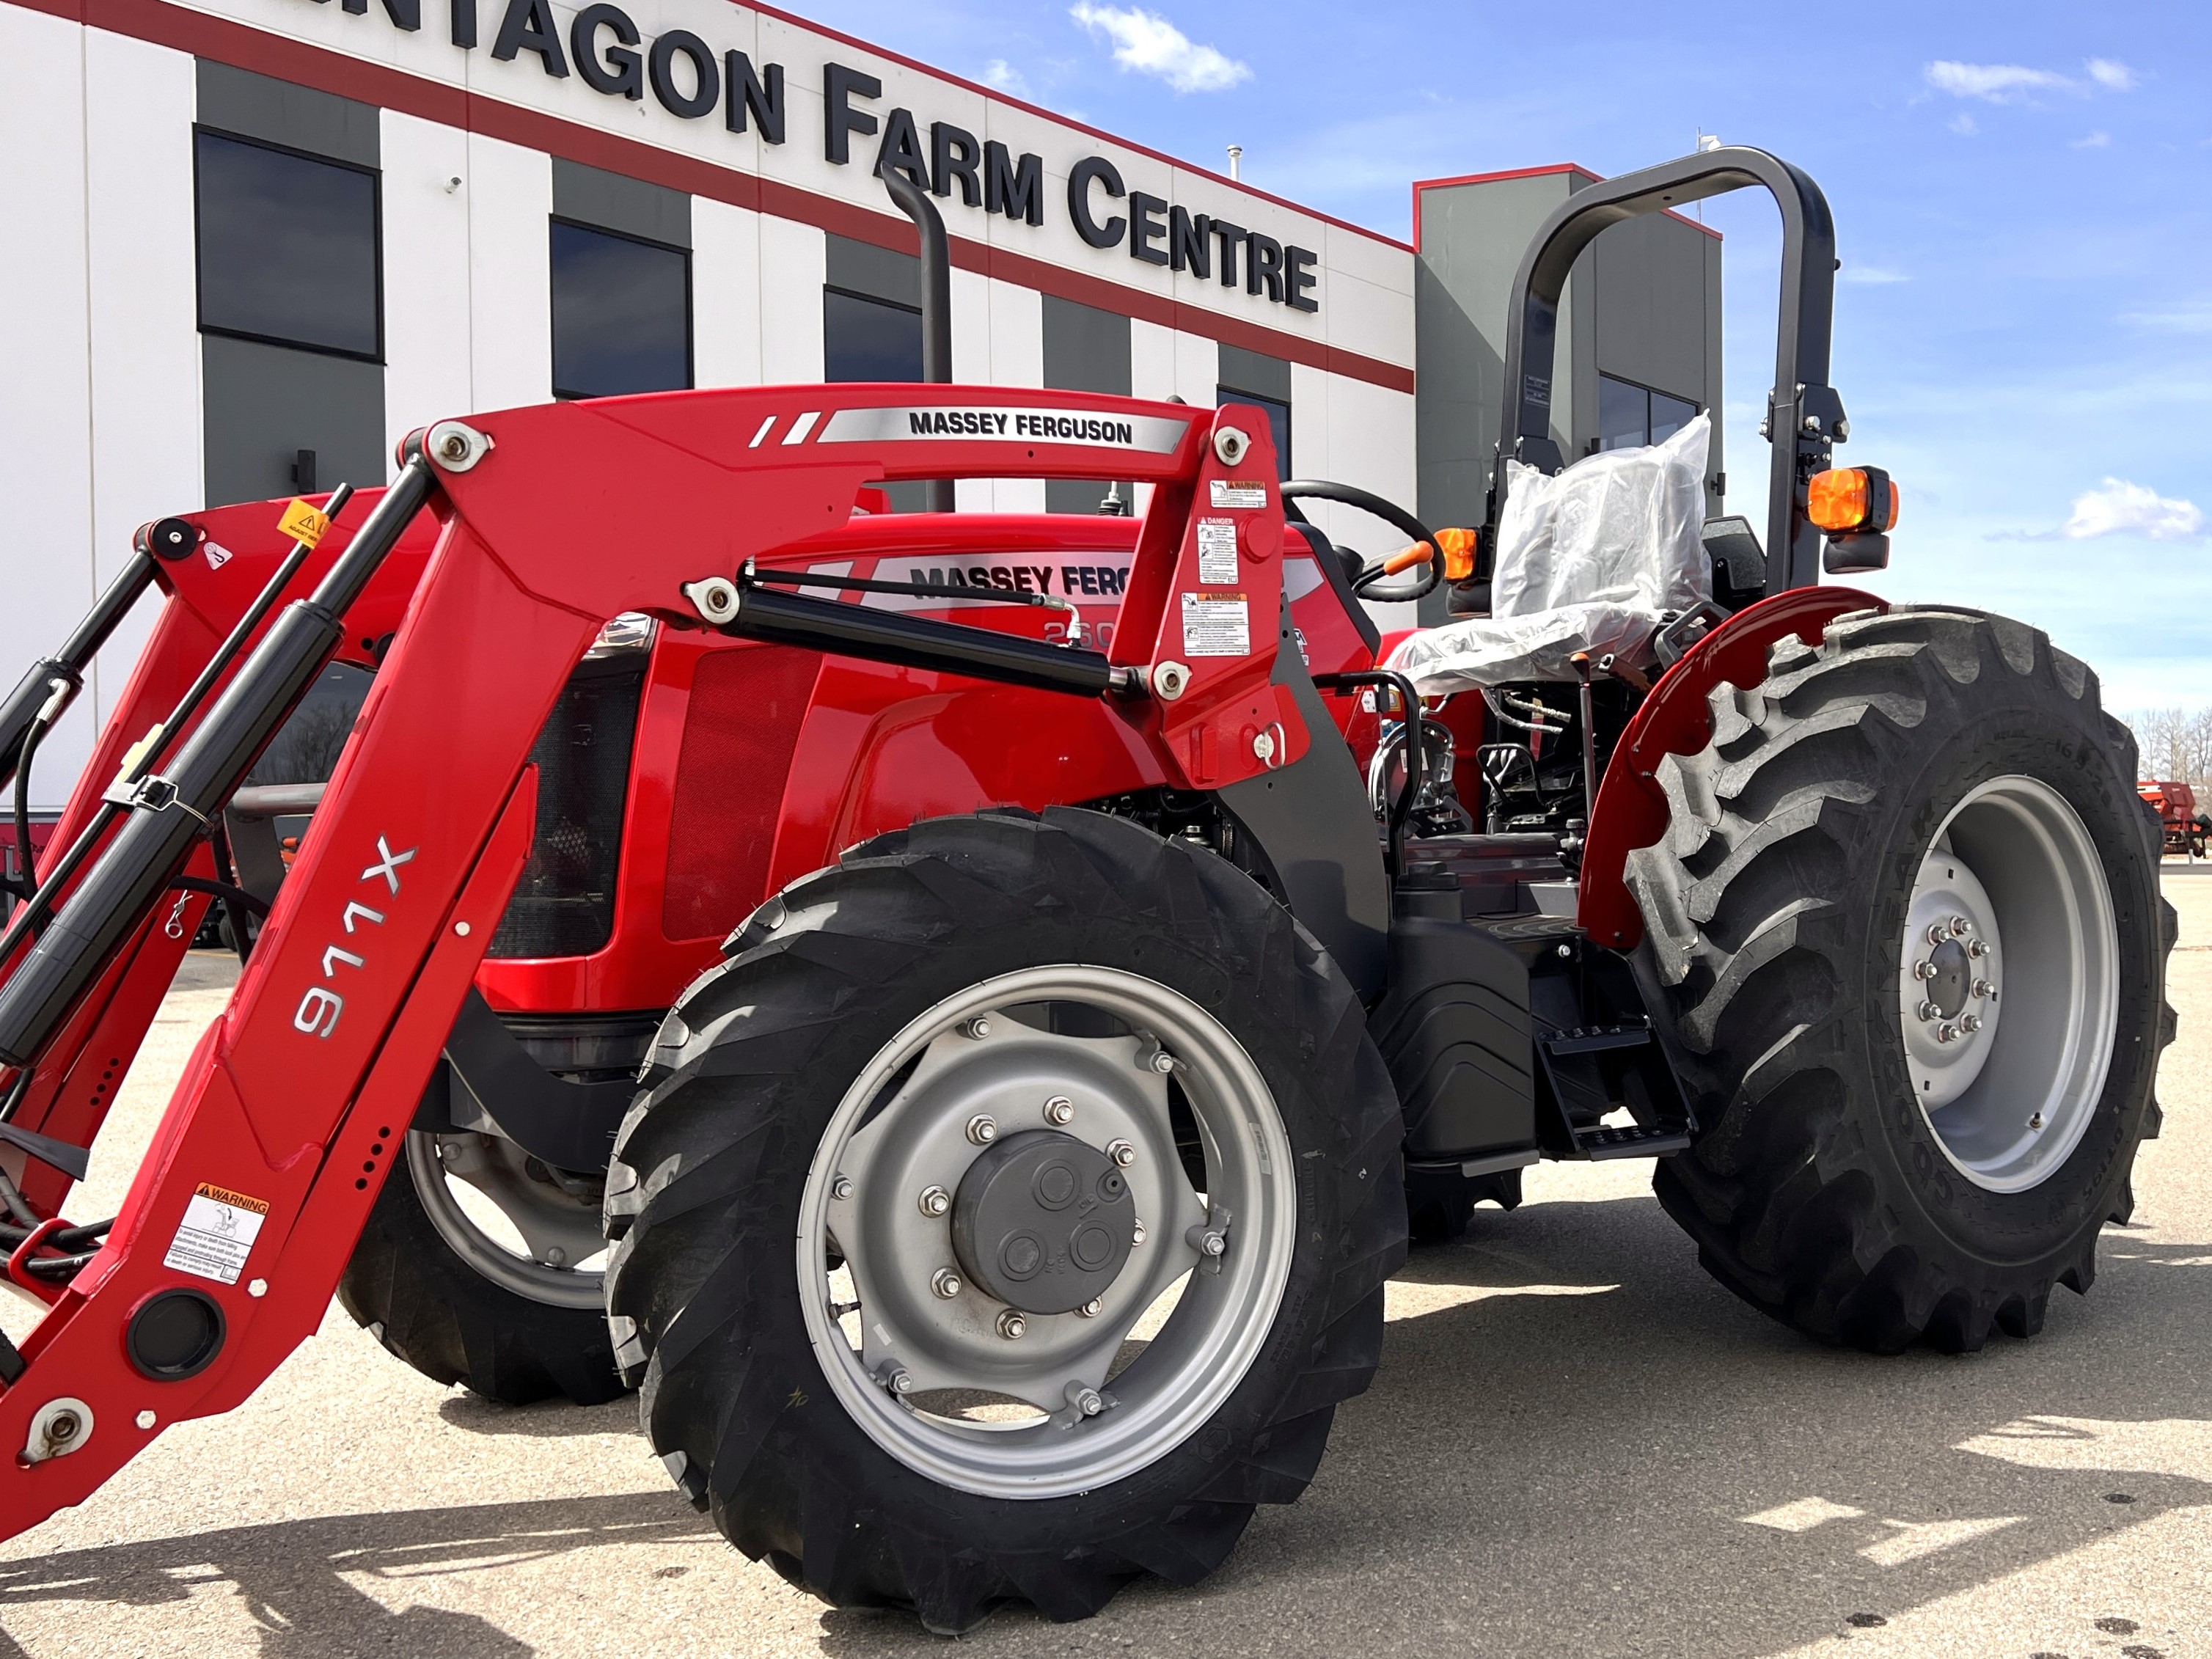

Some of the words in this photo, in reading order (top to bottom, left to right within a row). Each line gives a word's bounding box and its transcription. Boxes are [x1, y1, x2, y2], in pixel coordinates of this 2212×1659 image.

[307, 0, 785, 144] AGON
[824, 62, 1044, 227] FARM
[1068, 156, 1318, 312] CENTRE
[909, 412, 1008, 436] MASSEY
[1015, 414, 1132, 444] FERGUSON
[289, 525, 308, 536] ADJUST
[1207, 517, 1234, 525] DANGER
[910, 566, 1053, 599] MASSEY
[1212, 593, 1241, 601] WARNING
[293, 832, 420, 1039] 911X
[212, 1187, 267, 1213] WARNING
